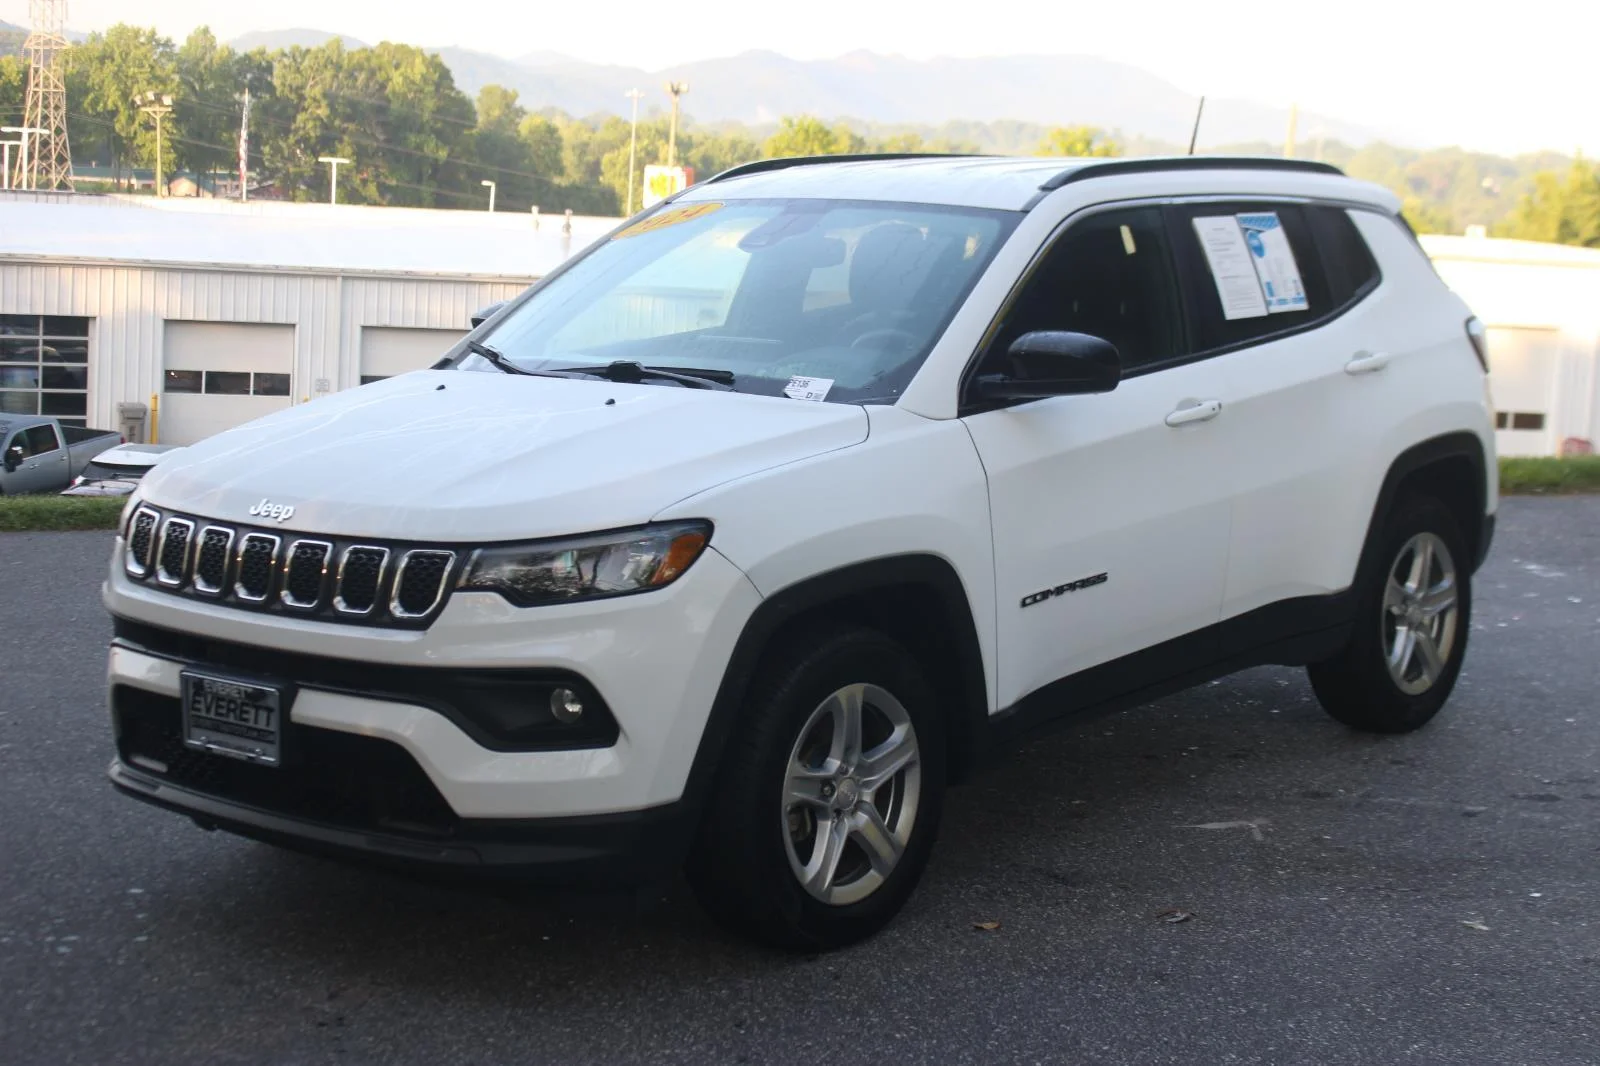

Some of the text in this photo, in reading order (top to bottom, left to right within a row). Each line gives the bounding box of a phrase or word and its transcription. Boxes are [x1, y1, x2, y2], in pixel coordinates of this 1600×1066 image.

[249, 498, 294, 523] Jeep
[1020, 572, 1108, 608] COMPASS
[191, 694, 275, 728] EVERETT
